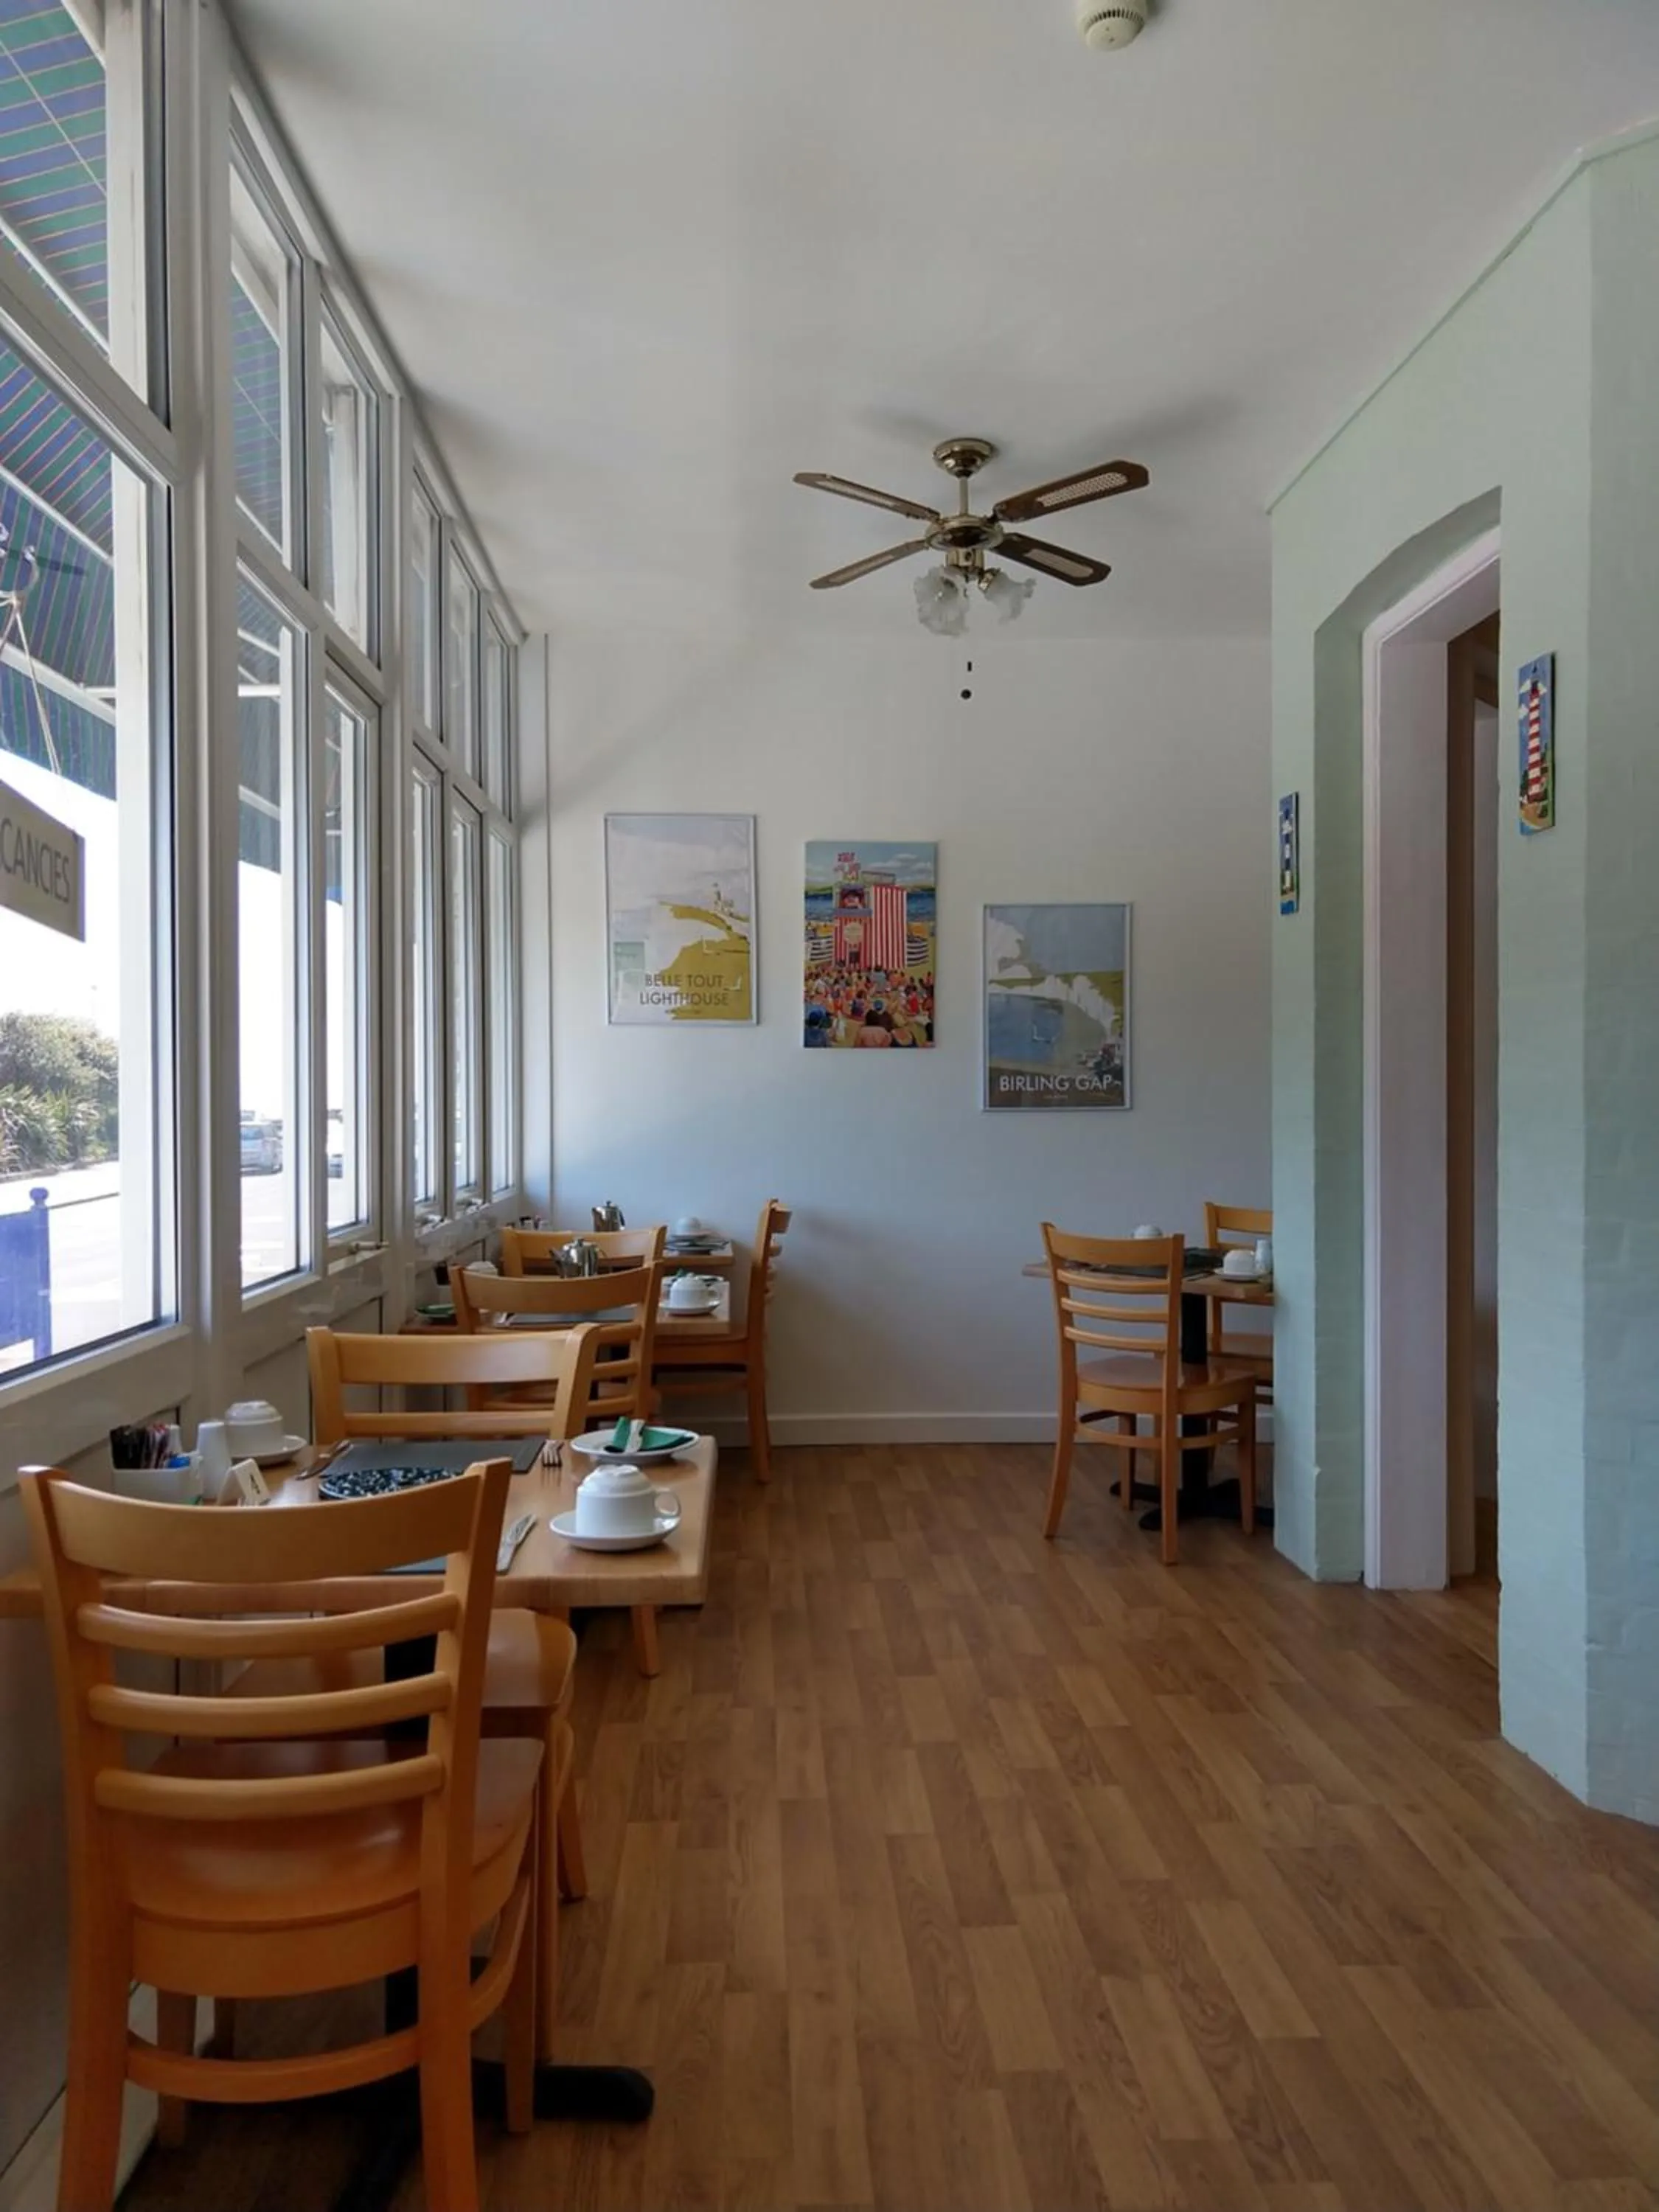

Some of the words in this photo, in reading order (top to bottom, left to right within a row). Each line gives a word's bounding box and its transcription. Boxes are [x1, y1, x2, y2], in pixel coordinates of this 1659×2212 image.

[0, 817, 70, 904] CANCIES
[644, 974, 681, 987] BELLE
[686, 974, 723, 988] TOUT
[639, 992, 728, 1006] LIGHTHOUSE
[999, 1075, 1069, 1091] BIRLING
[1075, 1074, 1112, 1091] GAP
